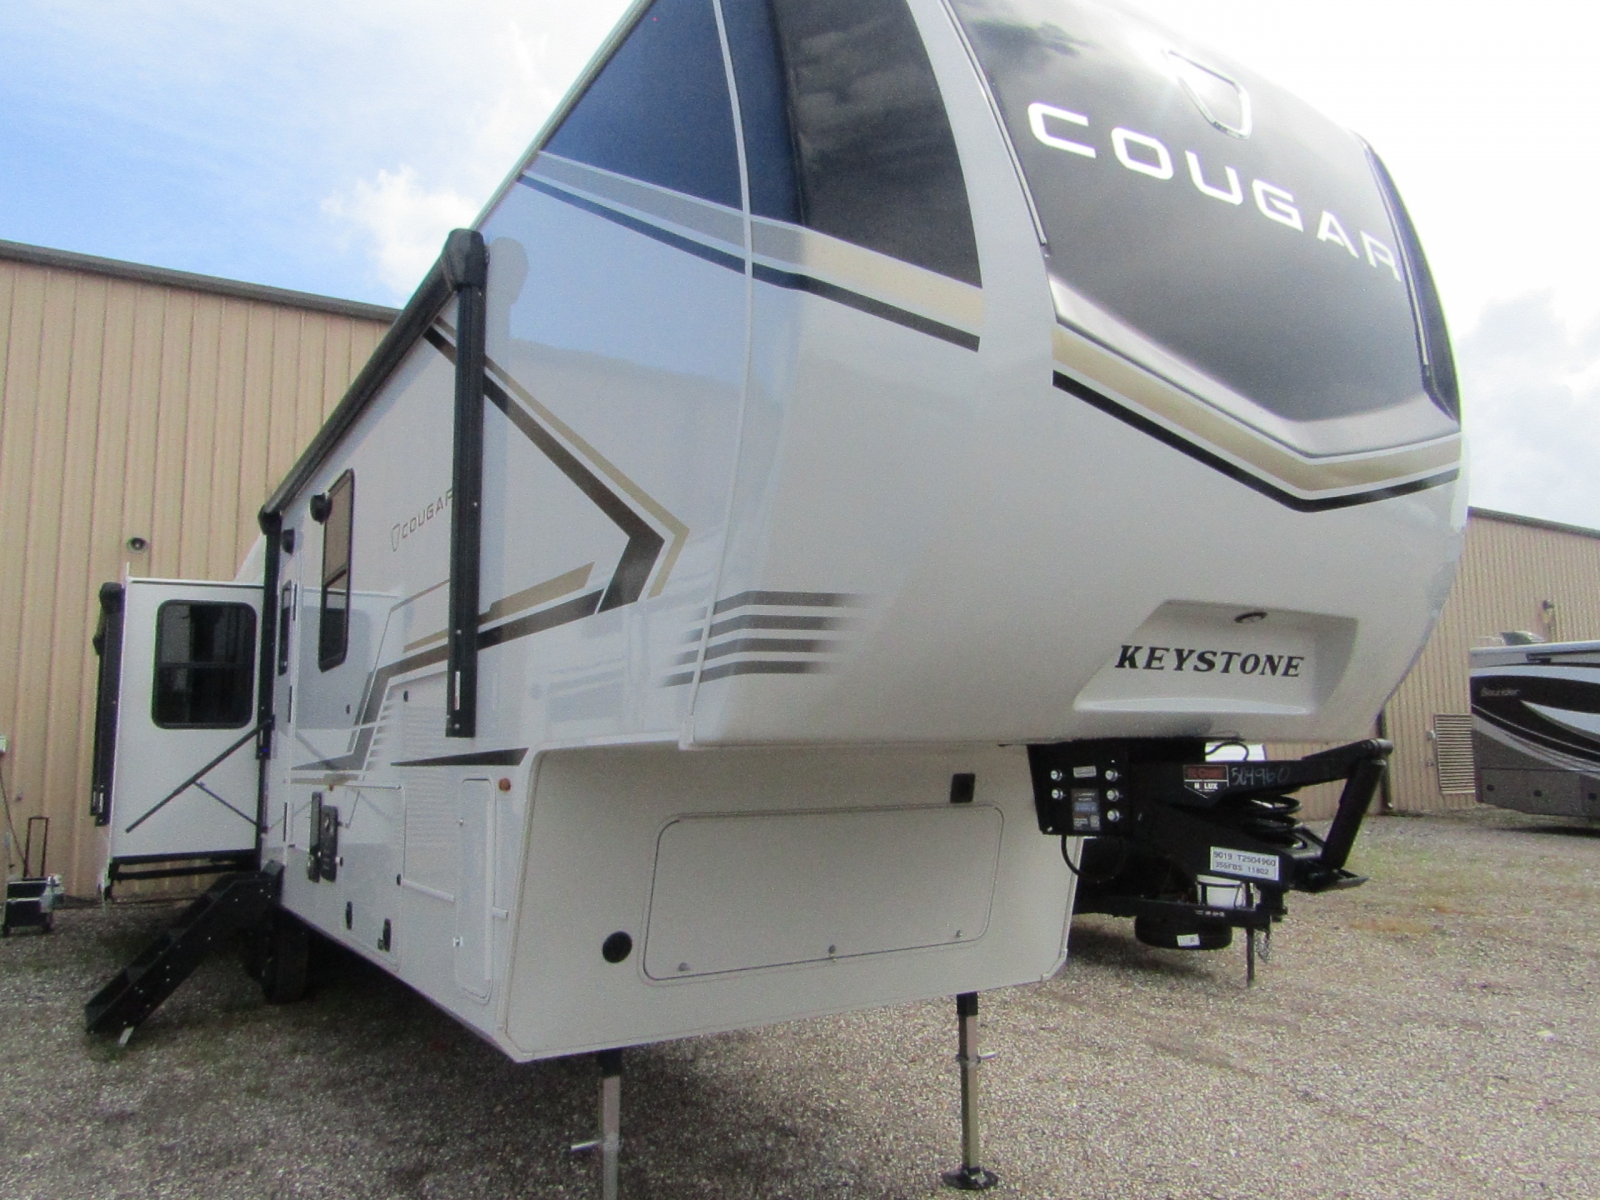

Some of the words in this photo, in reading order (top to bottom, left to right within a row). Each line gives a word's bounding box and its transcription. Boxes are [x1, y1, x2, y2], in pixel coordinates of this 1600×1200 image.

[1027, 102, 1401, 283] COUGAR
[1115, 645, 1305, 677] KEYSTONE
[1237, 854, 1276, 867] T2504960
